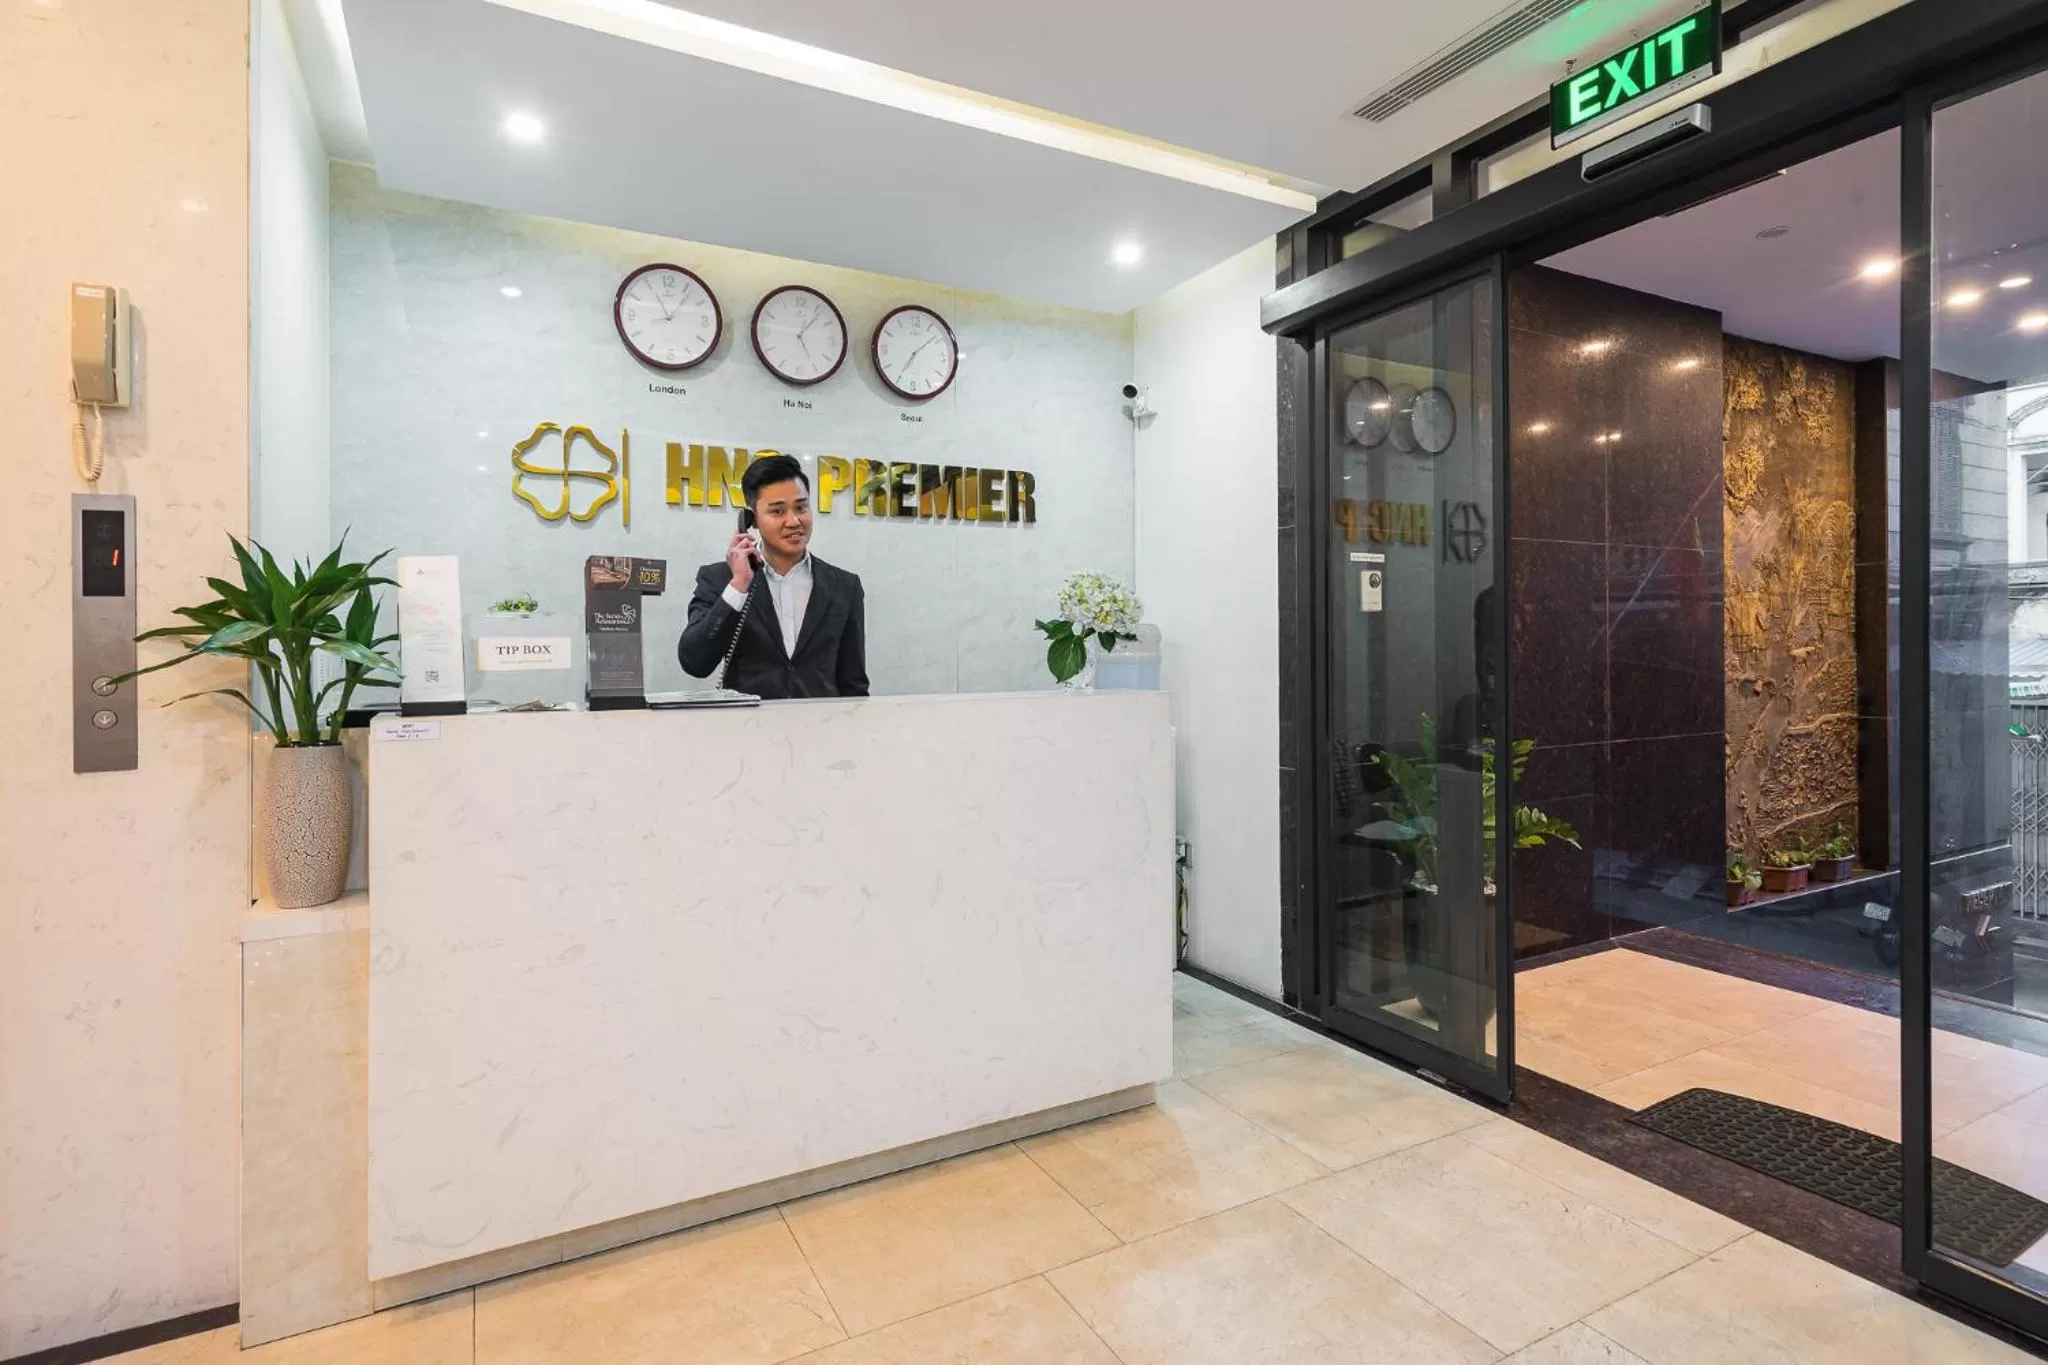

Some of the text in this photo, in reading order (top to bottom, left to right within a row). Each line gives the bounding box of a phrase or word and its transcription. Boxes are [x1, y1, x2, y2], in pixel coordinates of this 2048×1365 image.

[1569, 18, 1696, 125] EXIT
[649, 383, 686, 395] London
[783, 399, 812, 409] Ha Noi
[665, 442, 1036, 523] HN PREMIER
[640, 571, 660, 585] 10%
[496, 644, 552, 655] TIP BOX
